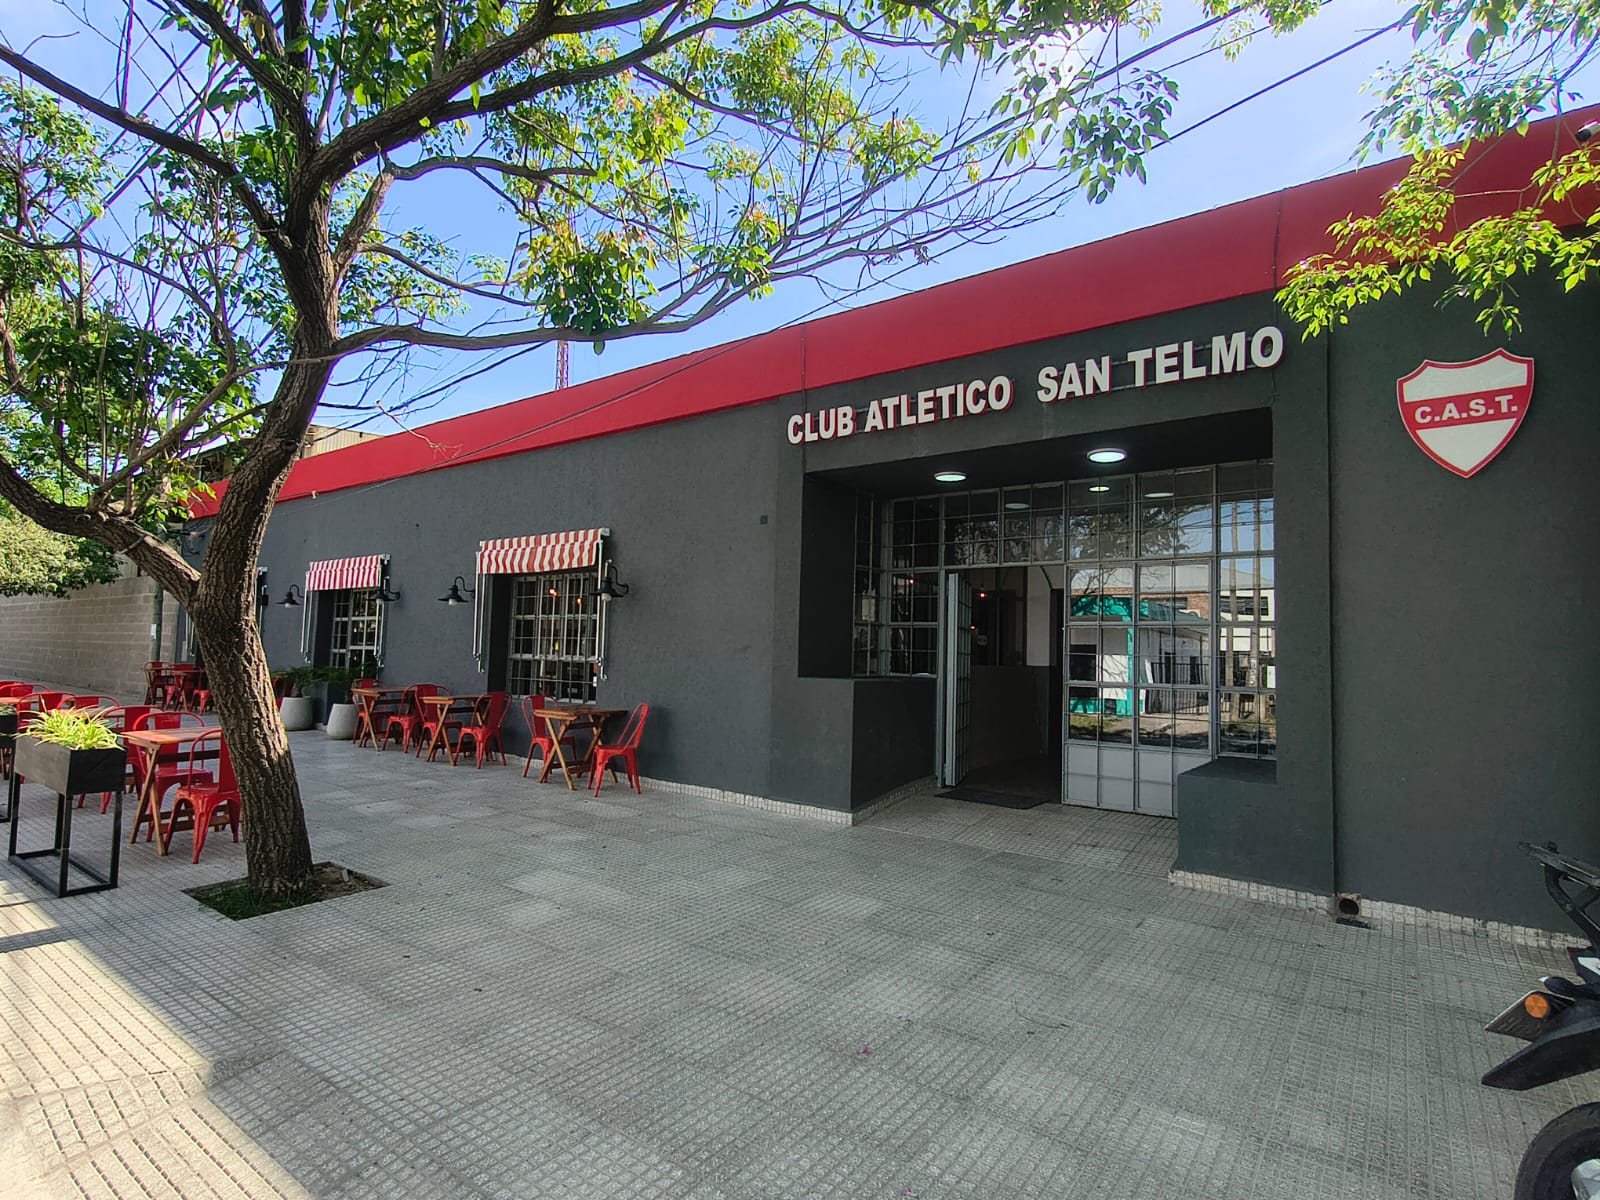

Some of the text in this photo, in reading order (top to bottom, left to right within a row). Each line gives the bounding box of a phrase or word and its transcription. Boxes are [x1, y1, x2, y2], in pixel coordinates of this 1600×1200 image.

[788, 326, 1285, 445] CLUB ATLETICO SAN TELMO
[1414, 394, 1518, 424] C.A.S.T.
